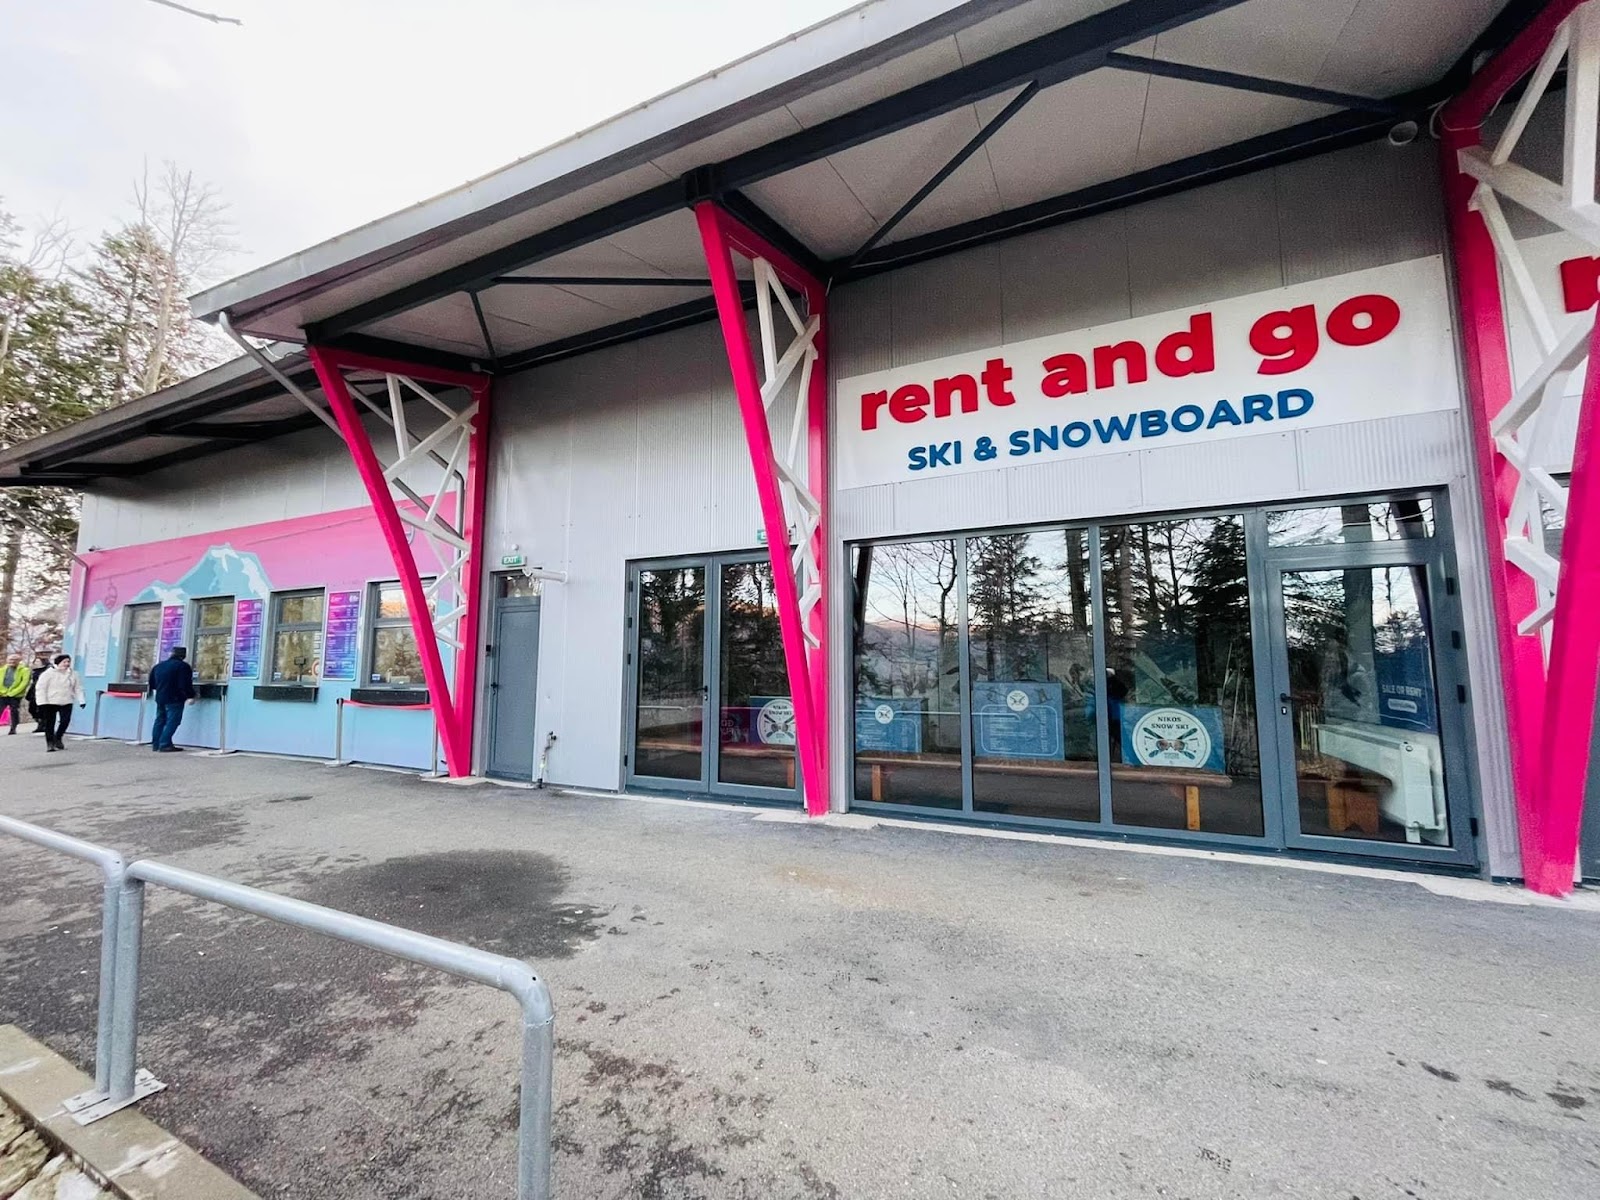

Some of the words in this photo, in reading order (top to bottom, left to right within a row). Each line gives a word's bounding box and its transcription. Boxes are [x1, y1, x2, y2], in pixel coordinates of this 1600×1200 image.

[861, 358, 1016, 431] rent
[1041, 312, 1215, 398] and
[1249, 294, 1401, 376] go
[908, 440, 962, 471] SKI
[973, 436, 998, 462] &
[1009, 388, 1315, 456] SNOWBOARD
[503, 556, 519, 564] EXIT
[1405, 686, 1421, 698] RENT
